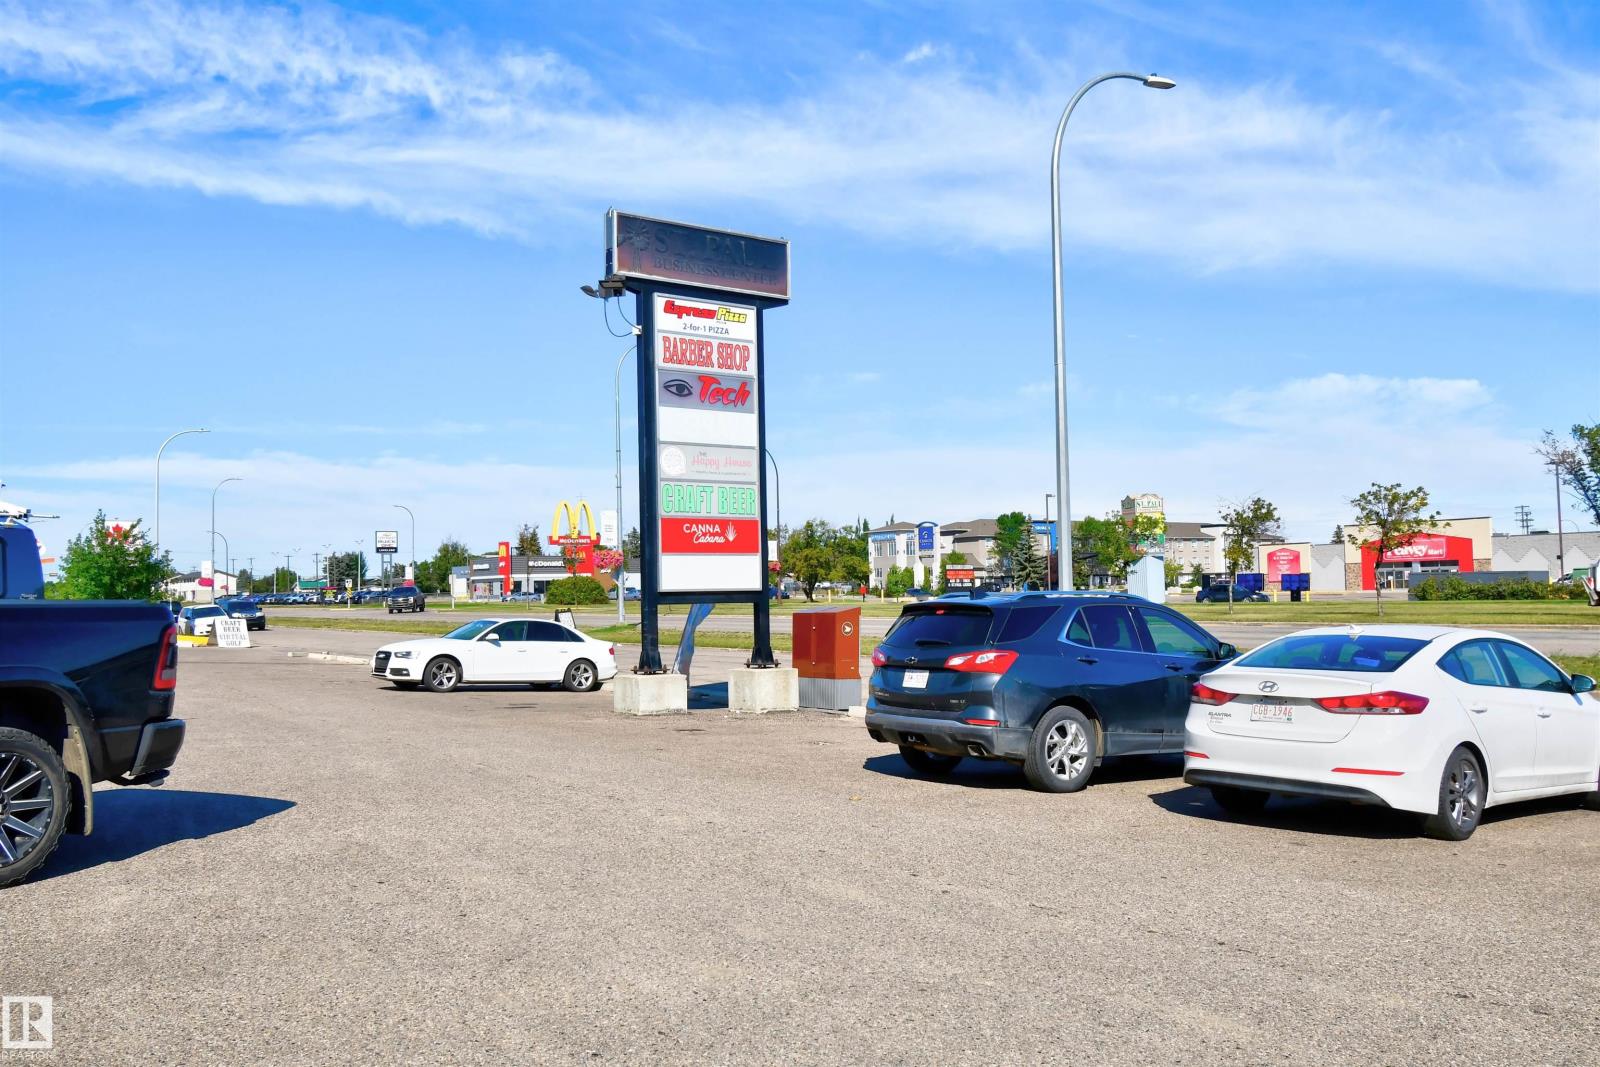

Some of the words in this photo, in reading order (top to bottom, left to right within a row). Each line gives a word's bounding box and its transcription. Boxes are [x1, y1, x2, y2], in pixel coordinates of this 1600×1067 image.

[716, 306, 748, 324] Pizza
[682, 323, 707, 333] 2-for-1
[708, 326, 730, 335] PIZZA
[662, 335, 714, 368] BARBER
[717, 342, 750, 371] SHOP
[698, 375, 751, 407] Tech
[661, 483, 714, 514] CRAFT
[717, 486, 756, 516] BEER
[683, 523, 722, 533] CANNA
[693, 531, 726, 544] Cabana
[1253, 704, 1294, 718] CGB-1946
